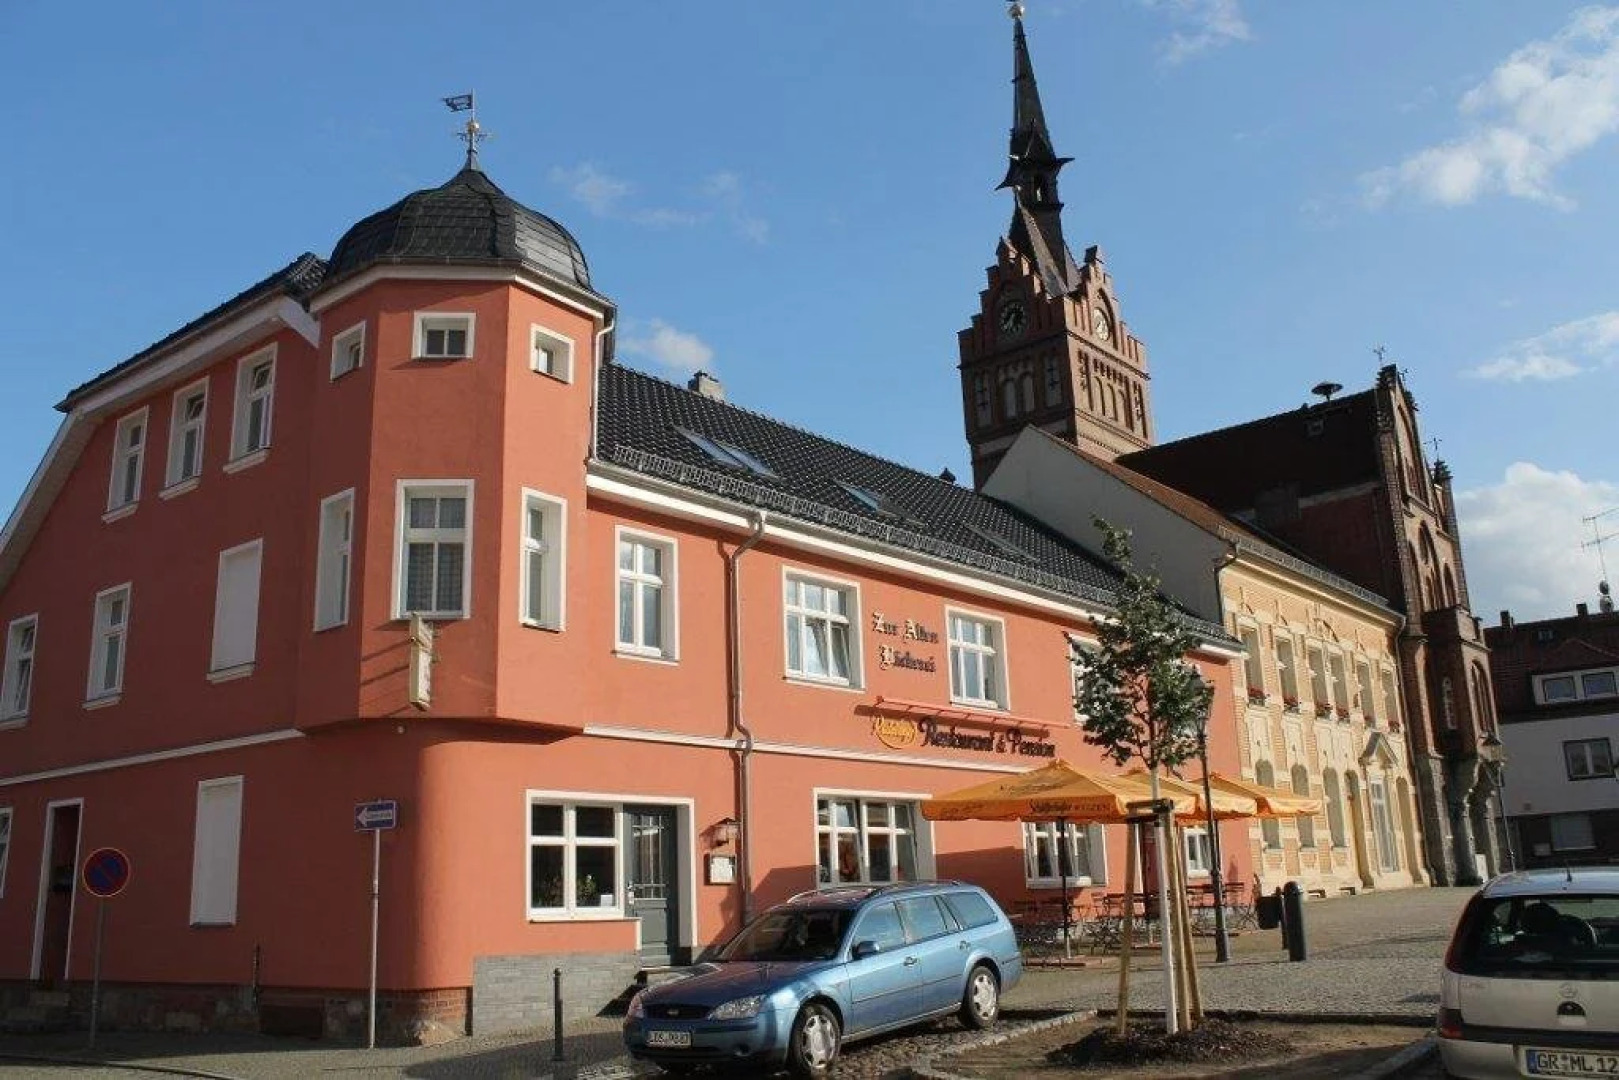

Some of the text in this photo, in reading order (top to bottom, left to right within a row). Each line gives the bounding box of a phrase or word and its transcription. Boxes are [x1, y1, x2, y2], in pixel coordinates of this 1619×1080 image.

[872, 611, 897, 636] Zur
[1536, 1052, 1560, 1070] GR
[1569, 1055, 1594, 1072] ML
